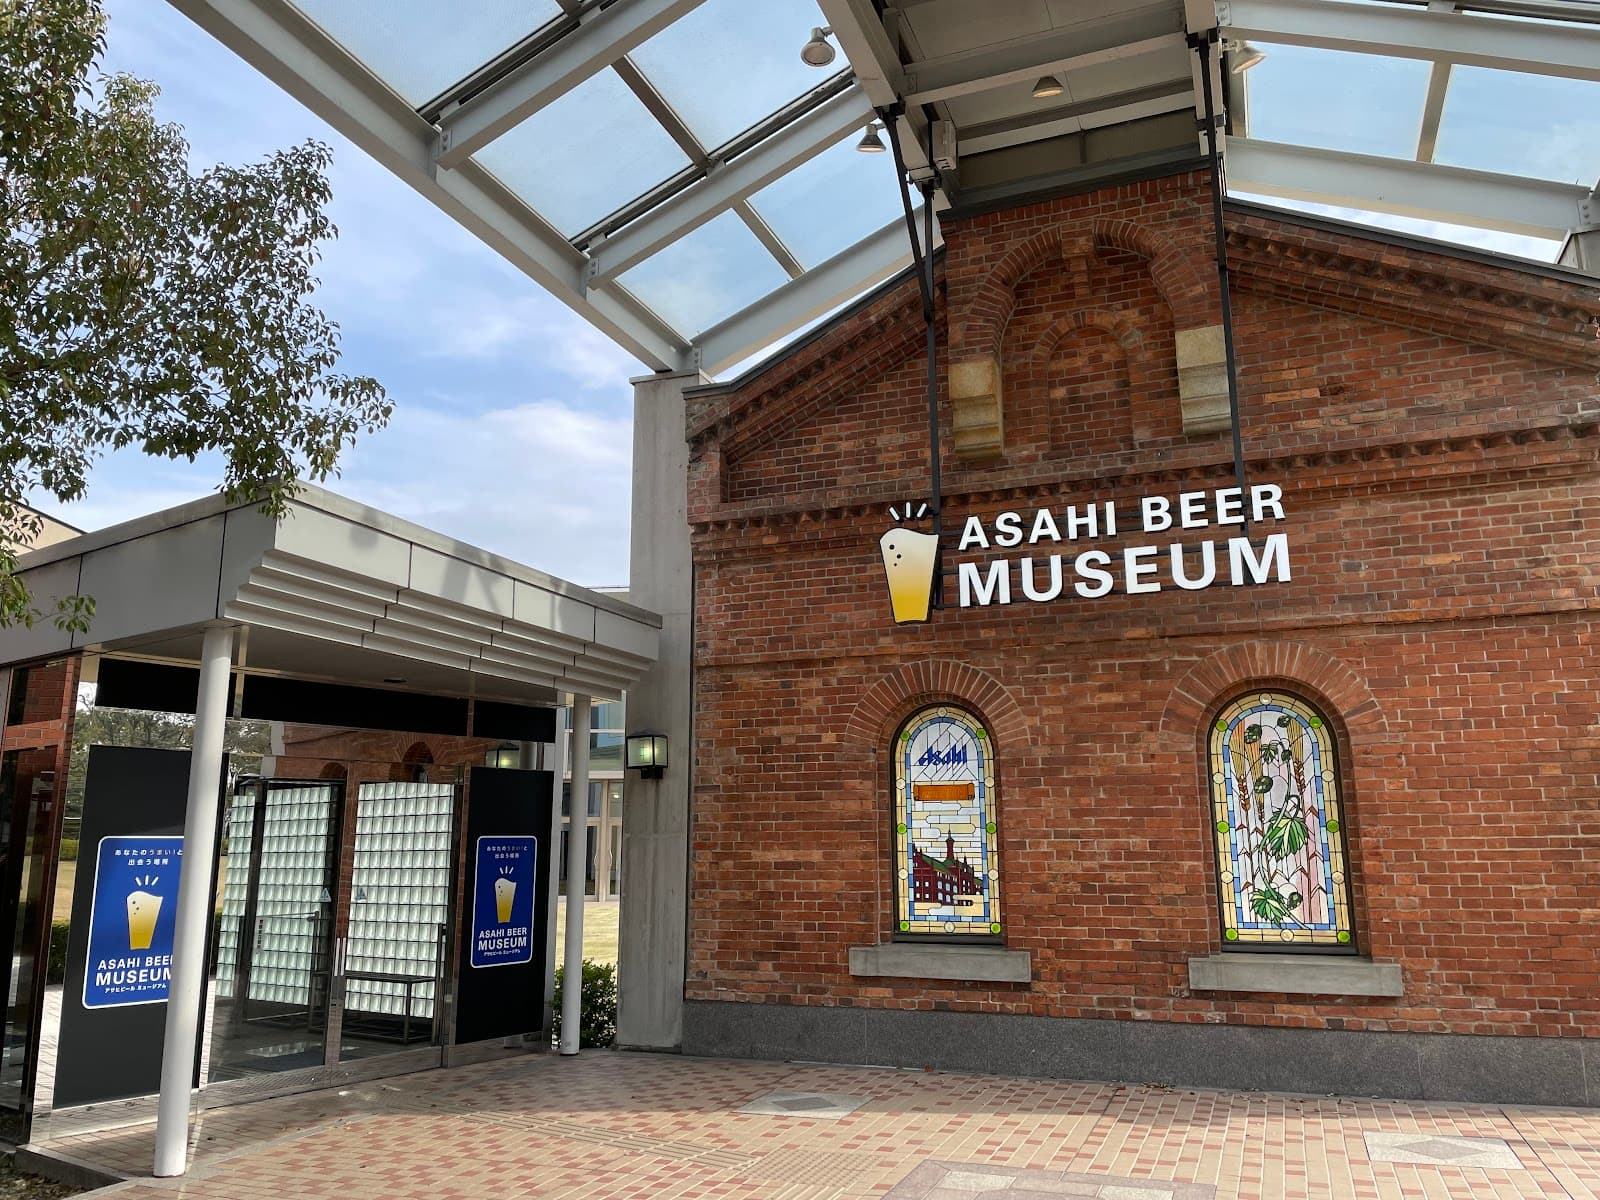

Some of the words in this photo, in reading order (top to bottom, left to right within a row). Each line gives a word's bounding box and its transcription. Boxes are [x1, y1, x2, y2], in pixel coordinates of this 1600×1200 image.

[958, 500, 1117, 551] ASAHI
[1141, 483, 1287, 533] BEER
[958, 532, 1292, 608] MUSEUM
[918, 743, 967, 766] Asahi
[479, 928, 505, 939] ASAHI
[507, 926, 528, 937] BEER
[478, 936, 527, 951] MUSEUM
[97, 957, 140, 971] ASAHI
[95, 967, 172, 987] MUSEUM
